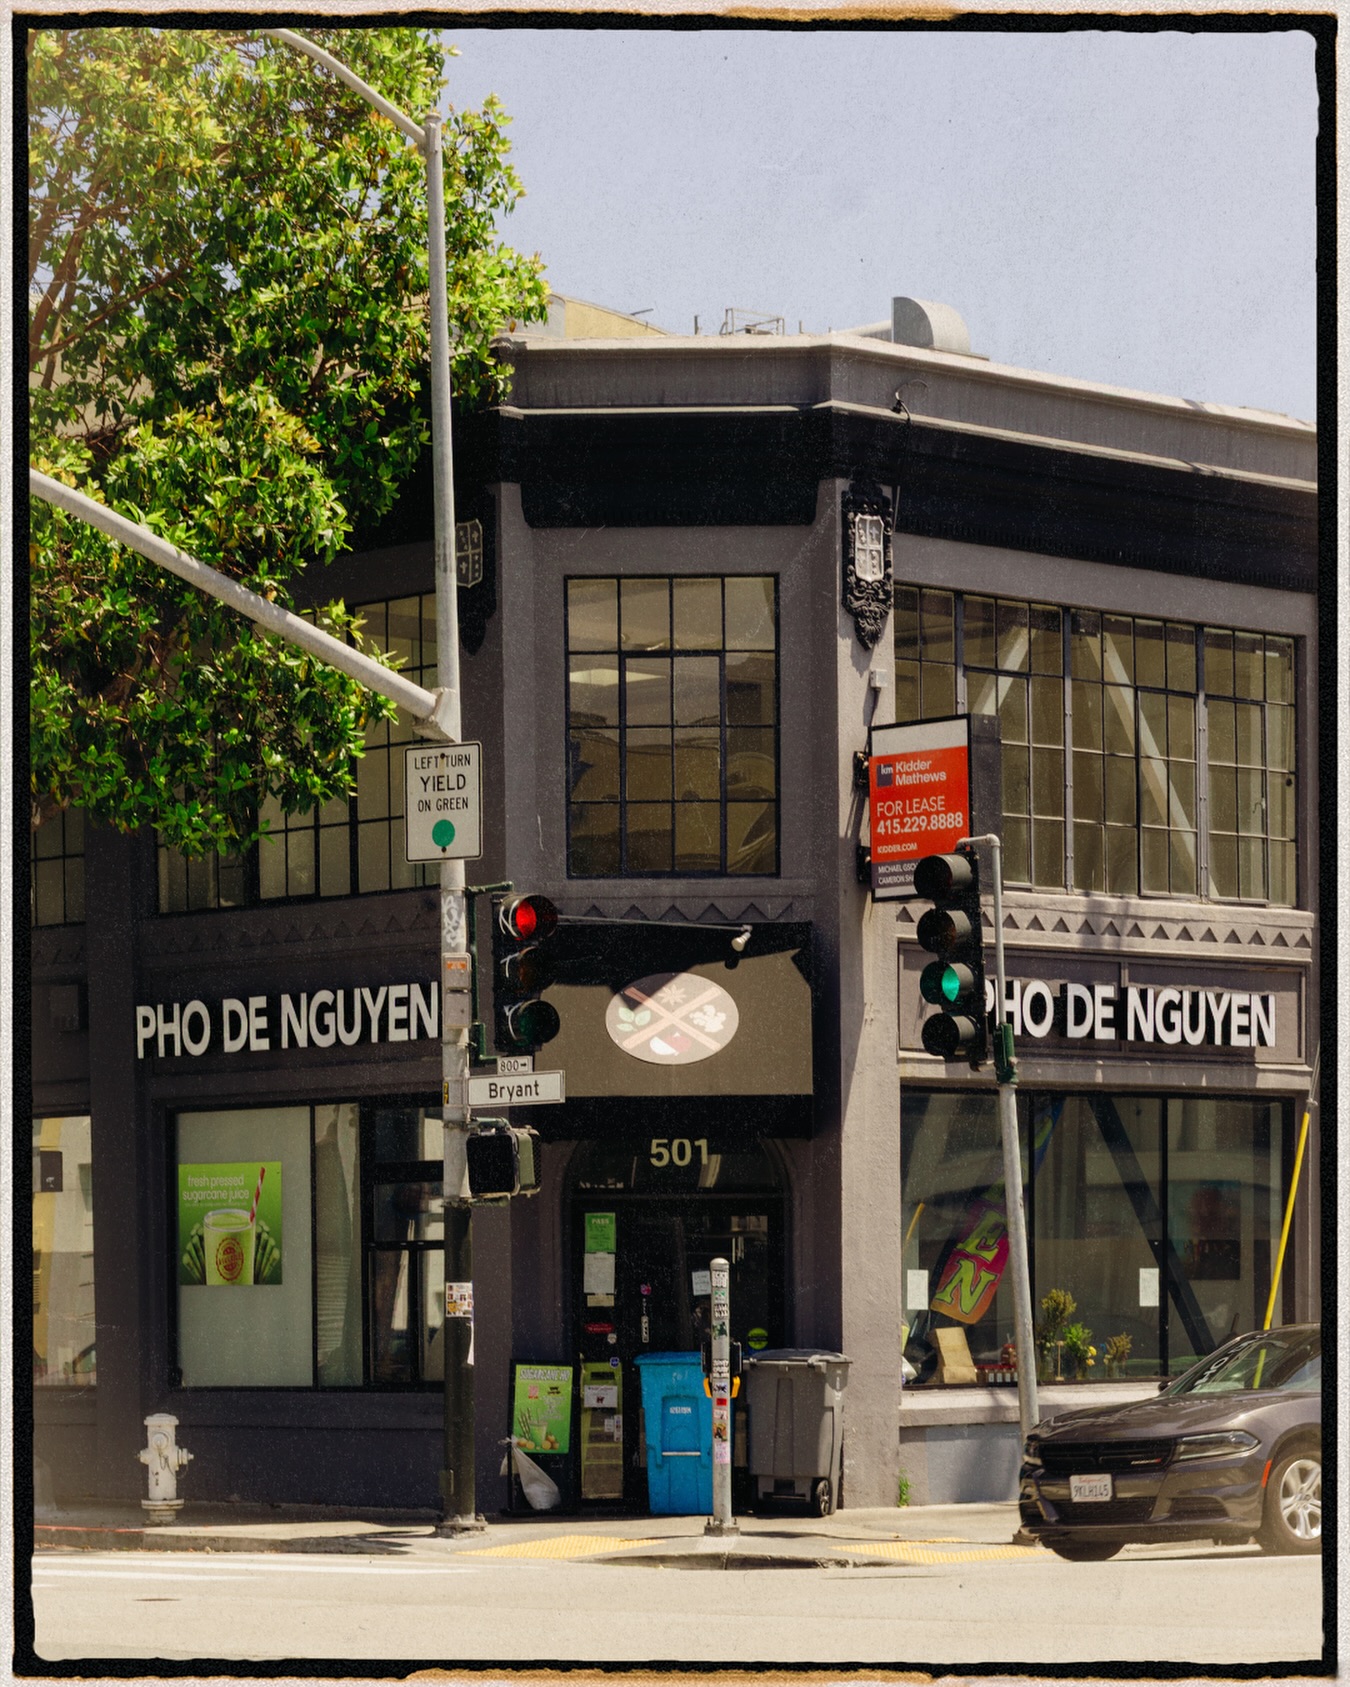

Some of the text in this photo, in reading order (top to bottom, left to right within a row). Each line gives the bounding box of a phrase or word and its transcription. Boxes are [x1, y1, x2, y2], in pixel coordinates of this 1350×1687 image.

[414, 753, 471, 770] LEFT TURN
[895, 759, 932, 773] Kidder
[420, 774, 466, 792] YIELD
[895, 771, 947, 786] Mathews
[417, 797, 469, 812] ON GREEN
[877, 795, 945, 817] FOR LEASE
[877, 811, 963, 835] 415.229.8888
[877, 842, 918, 854] KIDDER.COM
[136, 981, 439, 1059] PHO DE NGUYEN
[1066, 982, 1116, 1041] DE
[1127, 985, 1276, 1048] NGUYEN
[500, 1060, 519, 1072] 800
[488, 1080, 540, 1102] Bryant
[650, 1138, 709, 1167] 501
[188, 1174, 245, 1189] fresh pressed
[182, 1188, 250, 1203] sugarcane juice
